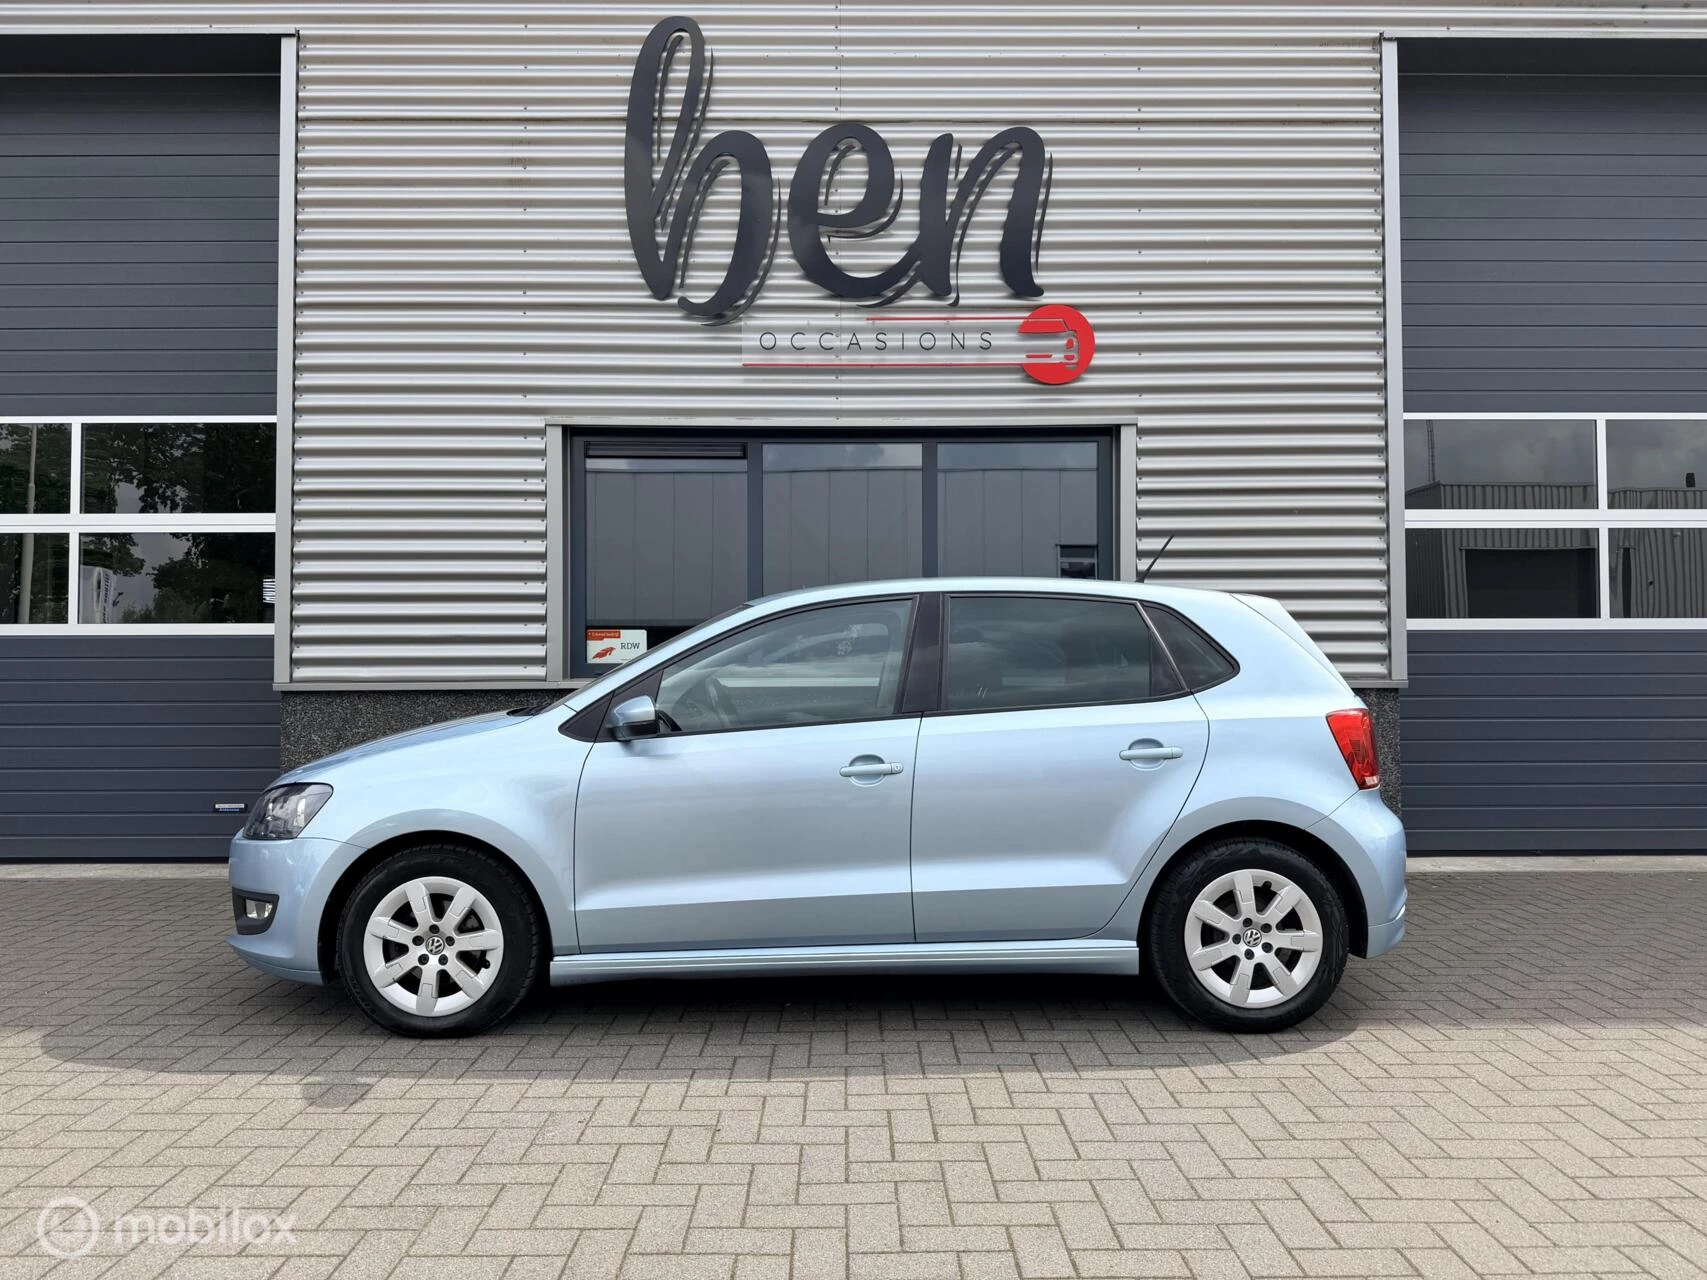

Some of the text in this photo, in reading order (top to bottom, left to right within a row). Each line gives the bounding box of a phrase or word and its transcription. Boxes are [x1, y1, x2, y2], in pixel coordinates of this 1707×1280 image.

[624, 16, 1049, 320] ben
[759, 331, 993, 350] OCCASIONS
[620, 642, 640, 650] RDW
